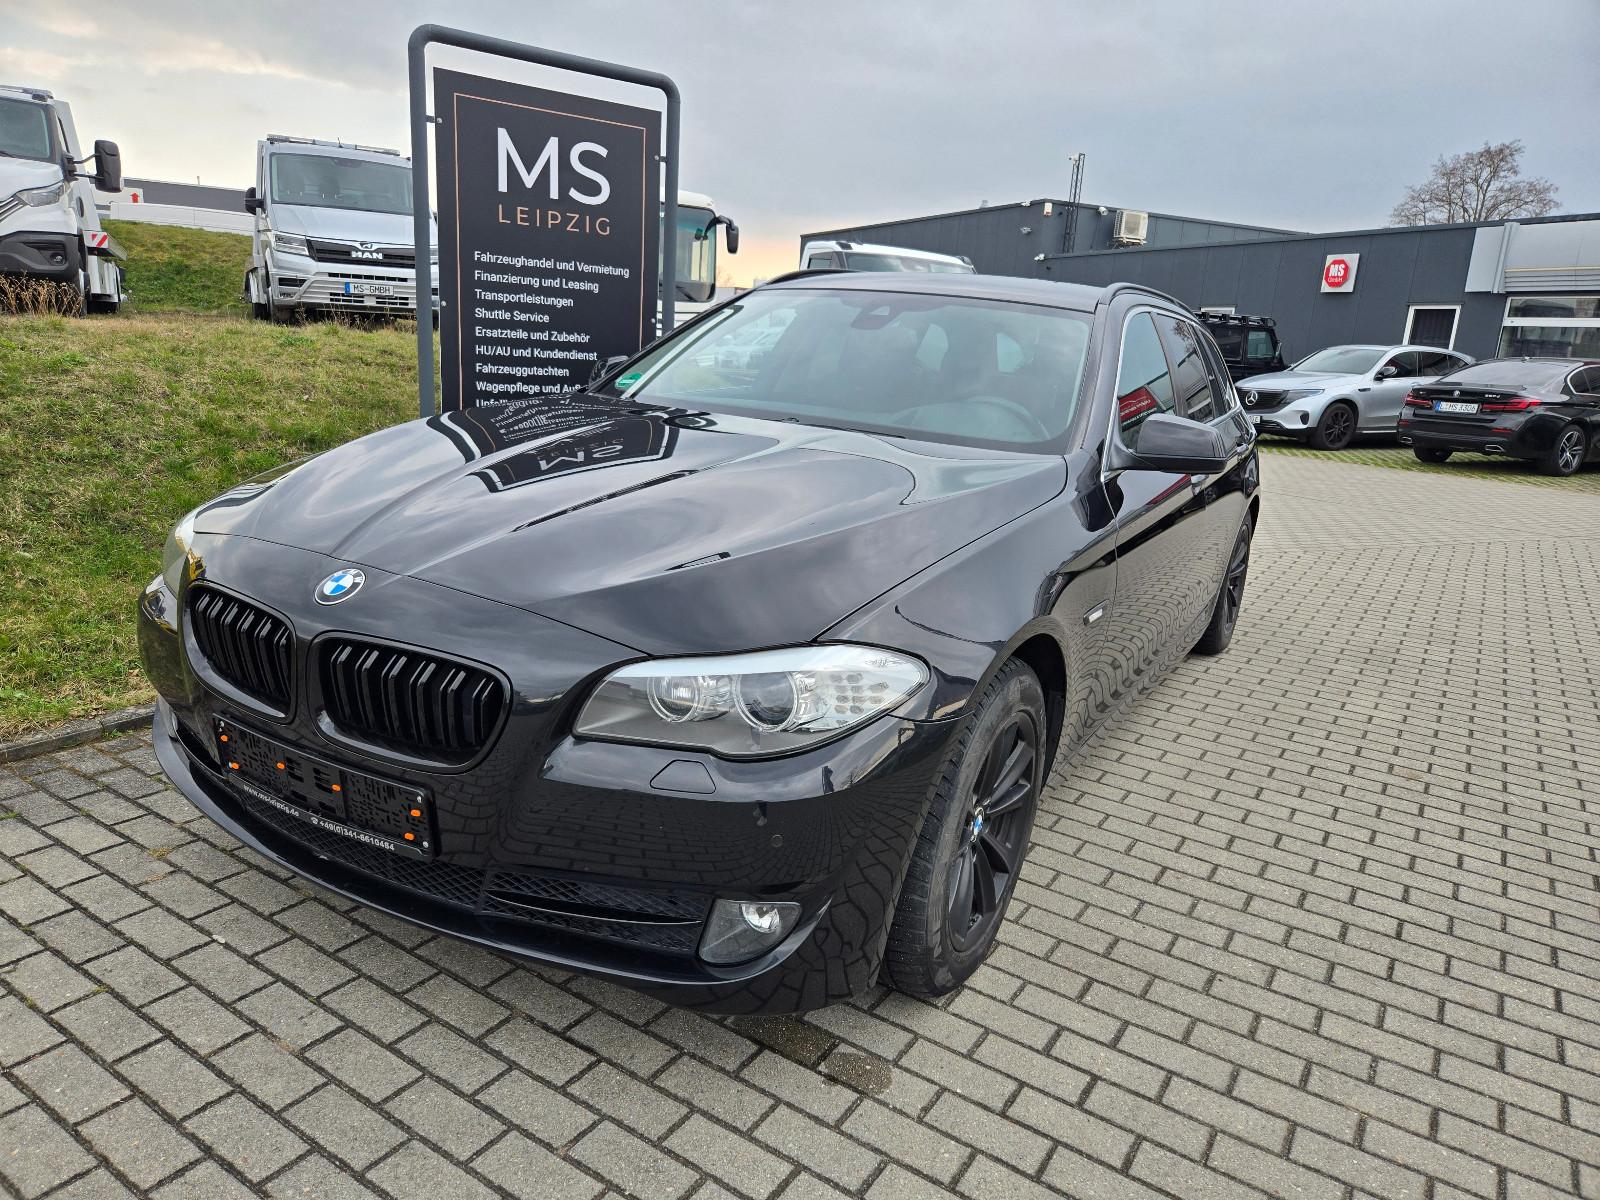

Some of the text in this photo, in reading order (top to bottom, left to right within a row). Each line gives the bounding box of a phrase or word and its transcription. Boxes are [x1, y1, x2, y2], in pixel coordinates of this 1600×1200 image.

[497, 127, 611, 206] MS
[498, 204, 610, 236] LEIPZIG
[351, 251, 383, 259] MAN
[474, 250, 630, 279] Fahrzeughandel und Vermietung
[1328, 263, 1346, 277] MS
[353, 284, 391, 294] MS-GMBH
[474, 270, 599, 294] Finanzierung und Leasing
[475, 288, 574, 309] Transportleistungen
[475, 307, 550, 323] Shuttle Service
[475, 326, 591, 343] Ersatzteile und Zubehör
[475, 345, 598, 361] HU/AU und Kundendienst
[475, 363, 570, 377] Fahrzeuggutachten
[476, 381, 541, 395] Wagenpflege
[542, 383, 560, 393] und
